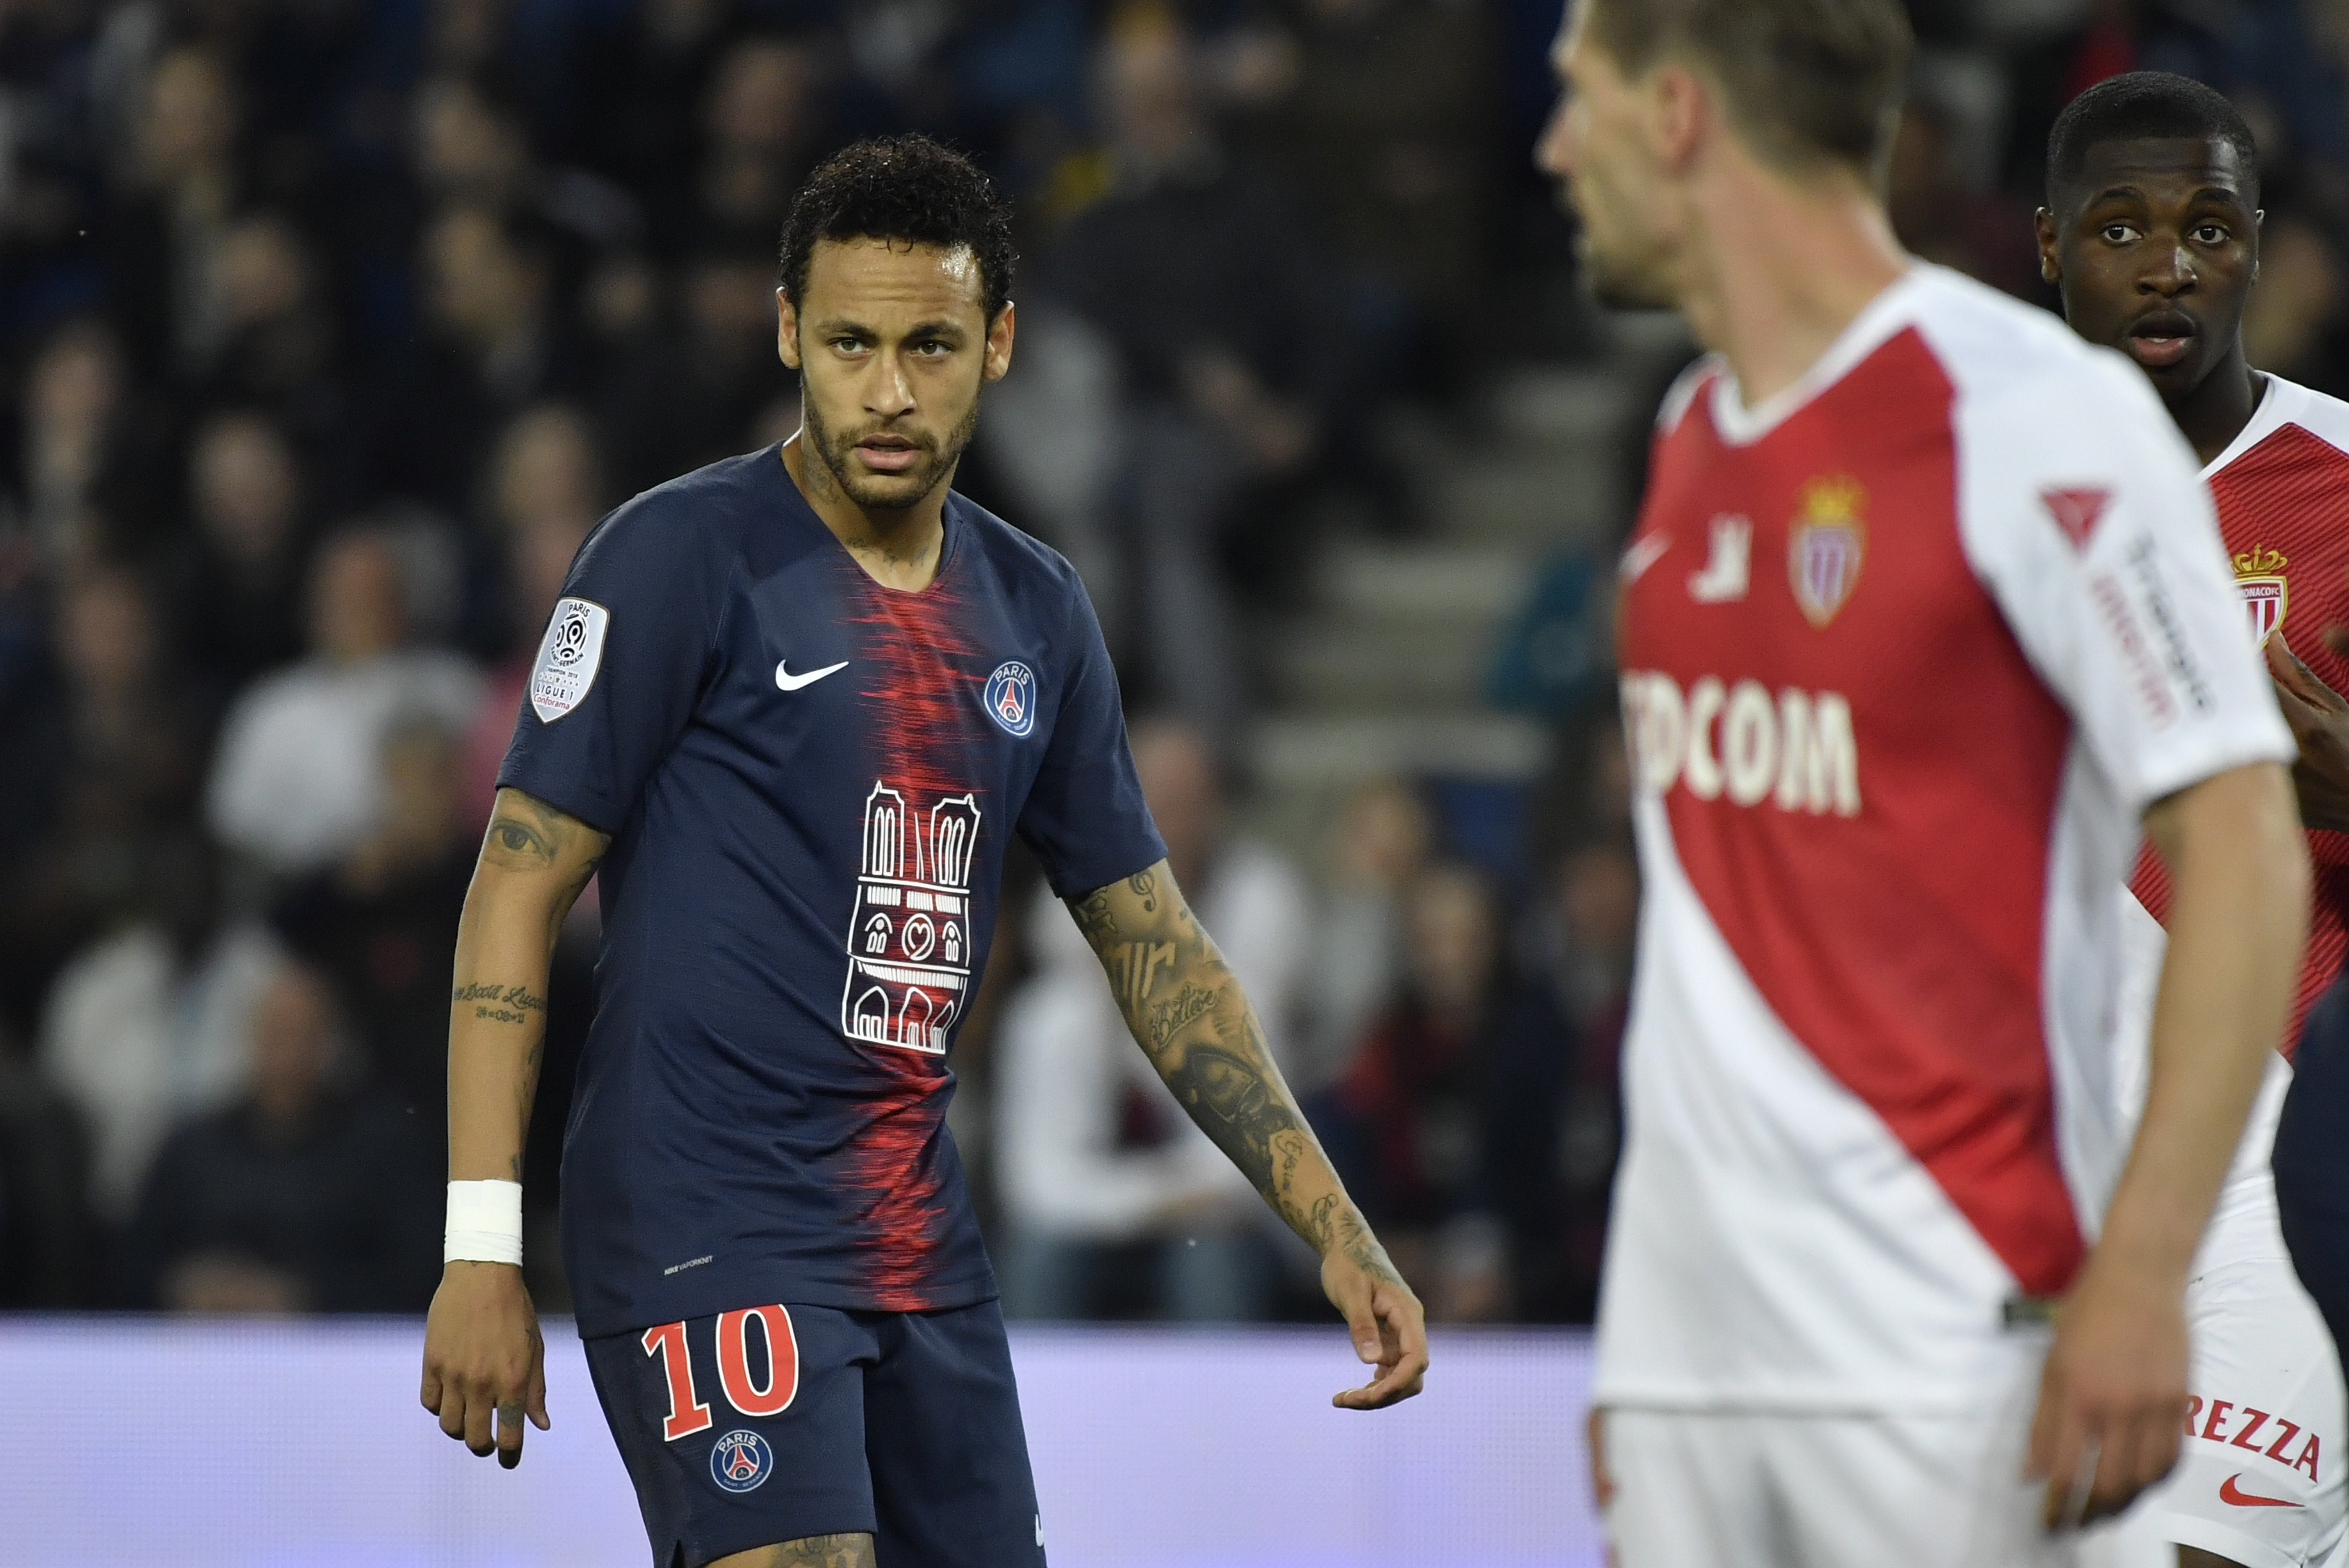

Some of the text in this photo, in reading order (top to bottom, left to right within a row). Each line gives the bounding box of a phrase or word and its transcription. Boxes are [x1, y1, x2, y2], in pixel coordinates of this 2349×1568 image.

[568, 603, 590, 617] PARIS
[995, 665, 1030, 685] PARIS
[536, 683, 574, 701] LIGUE 1
[533, 693, 570, 710] Conforama
[641, 1304, 799, 1441] 10
[718, 1433, 758, 1452] PARIS
